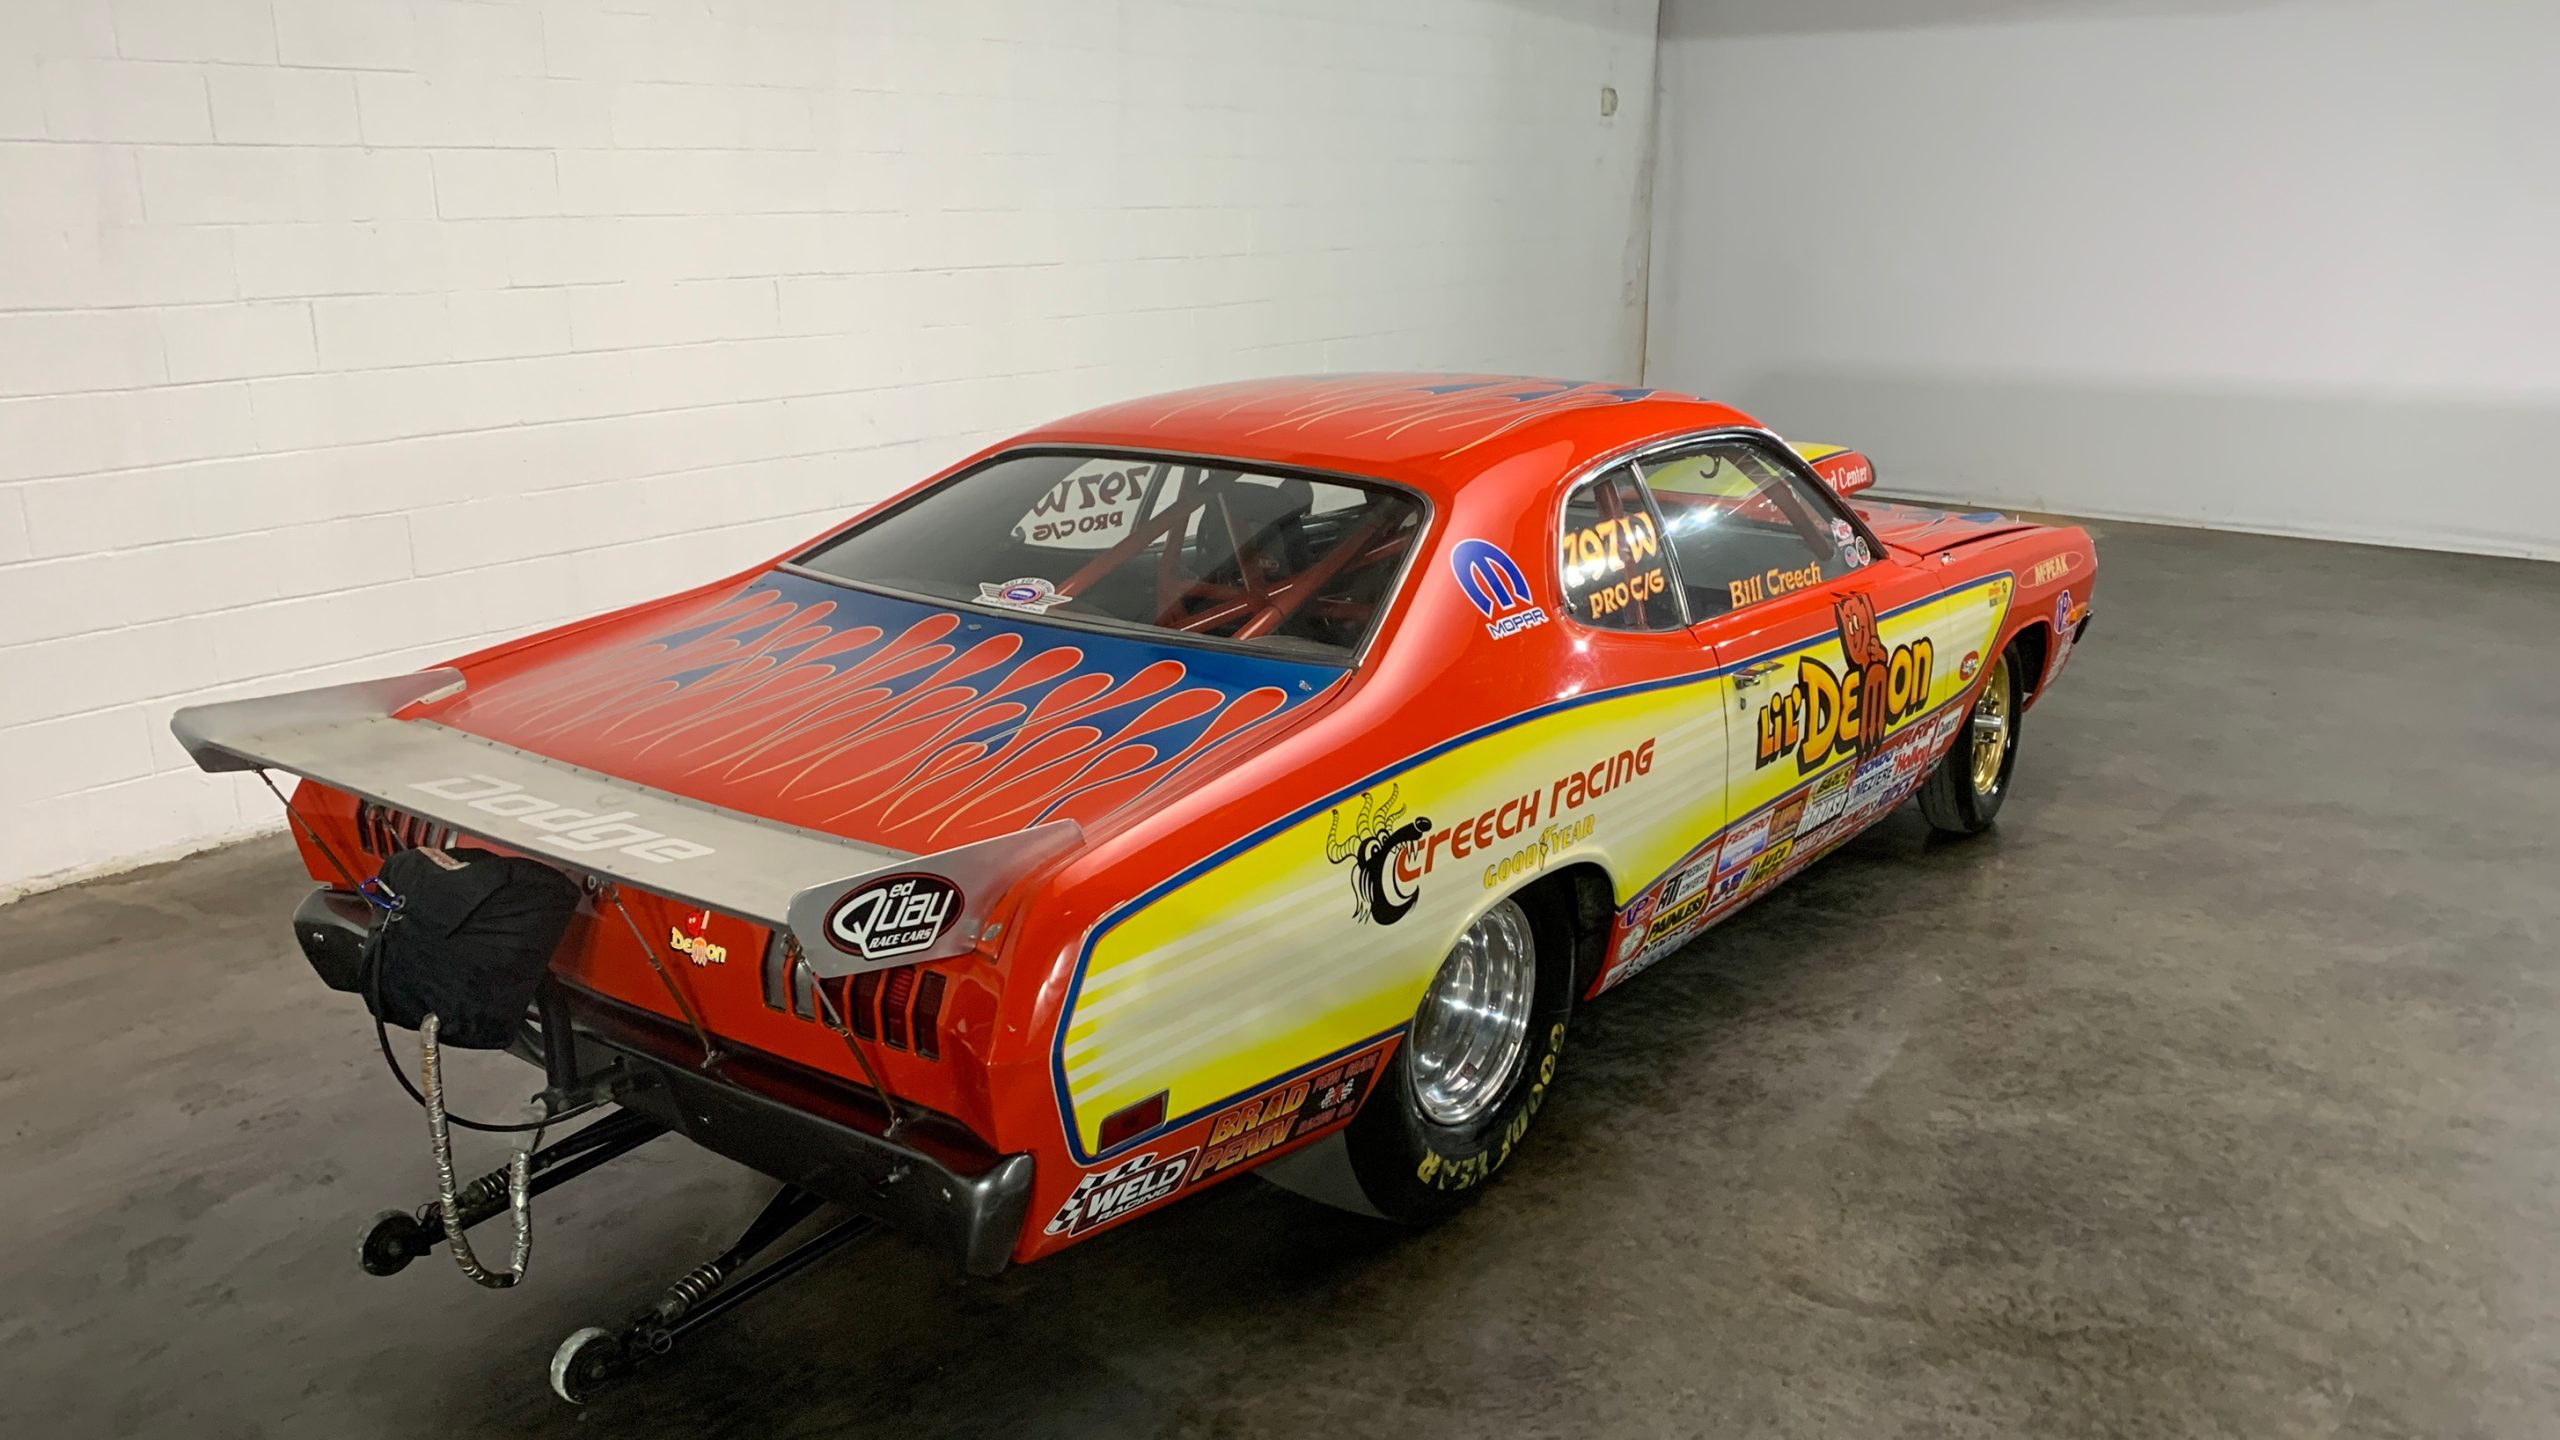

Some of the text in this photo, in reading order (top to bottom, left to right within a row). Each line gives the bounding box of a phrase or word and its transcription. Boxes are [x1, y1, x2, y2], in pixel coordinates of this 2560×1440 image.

[1838, 466, 1867, 489] Center
[1728, 560, 1823, 610] Bill Creech
[1486, 607, 1548, 639] MOPAR
[407, 773, 717, 864] Dodge
[868, 927, 933, 950] RACE CARS
[1209, 1081, 1311, 1148] BRAD
[1191, 1113, 1300, 1183] PENN
[1088, 1157, 1188, 1219] WELD
[1096, 1186, 1171, 1224] RACING
